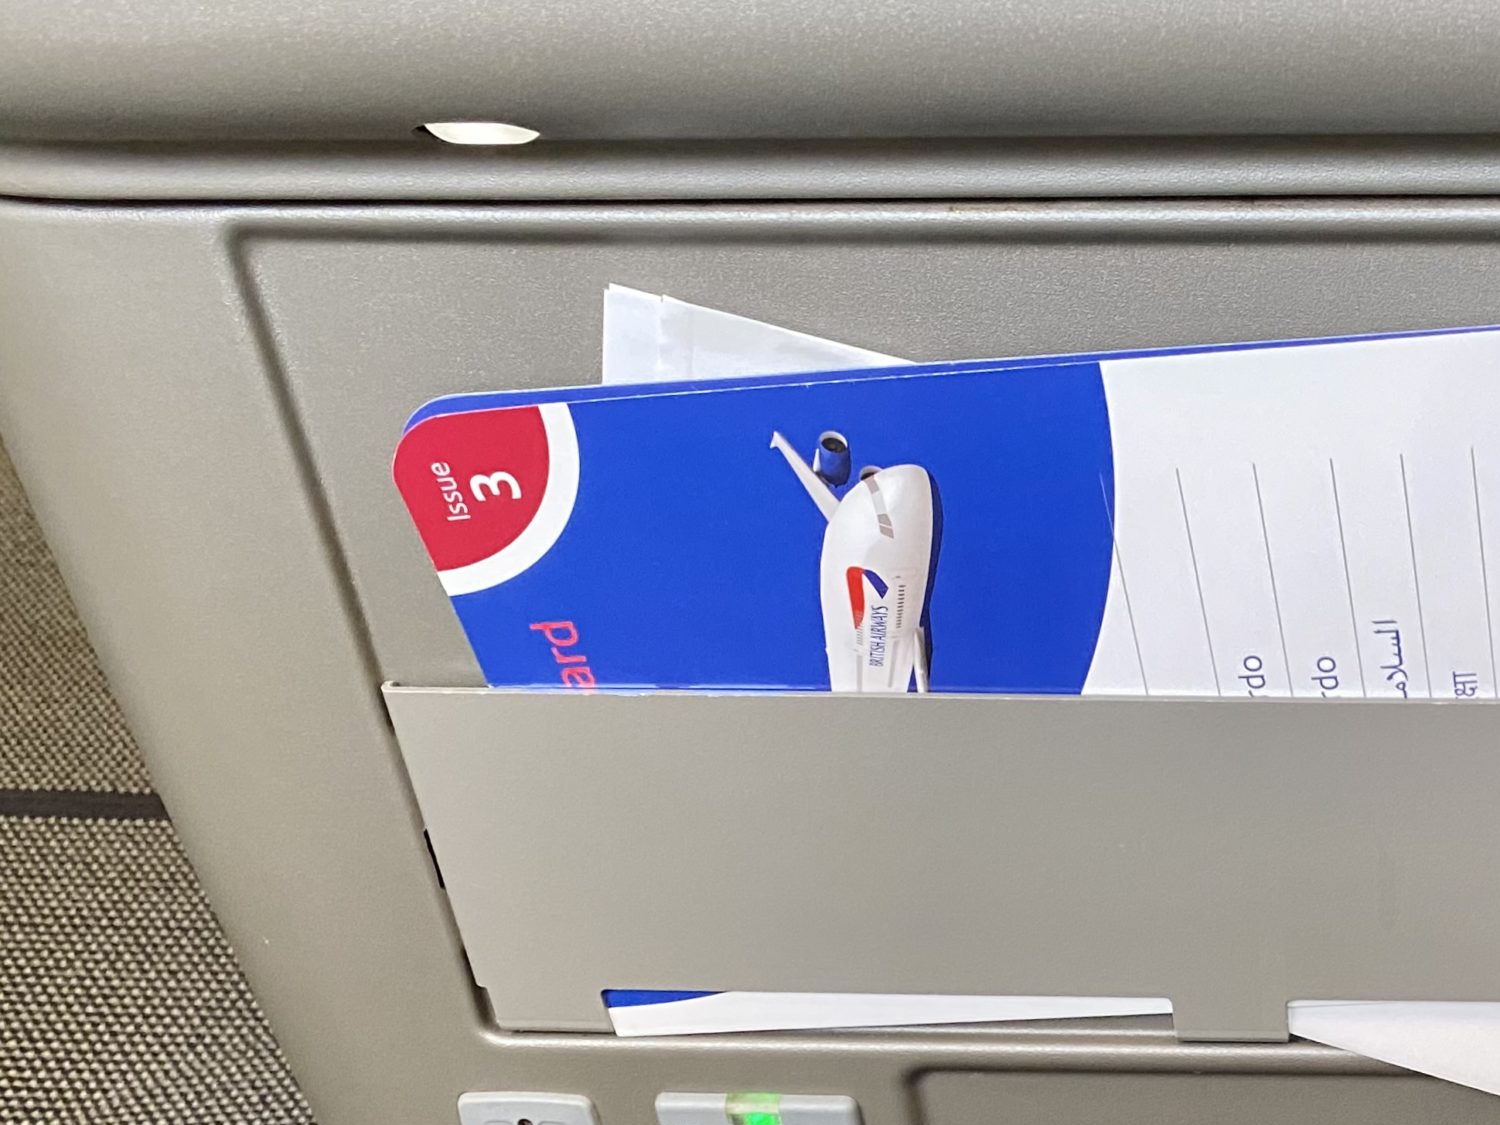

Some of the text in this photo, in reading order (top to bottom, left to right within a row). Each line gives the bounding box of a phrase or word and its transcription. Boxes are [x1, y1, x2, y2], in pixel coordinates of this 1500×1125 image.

[431, 462, 471, 521] Issue
[469, 471, 522, 502] 3
[869, 604, 889, 667] BRITISH AIRWAYS
[1452, 671, 1478, 699] क्षा
